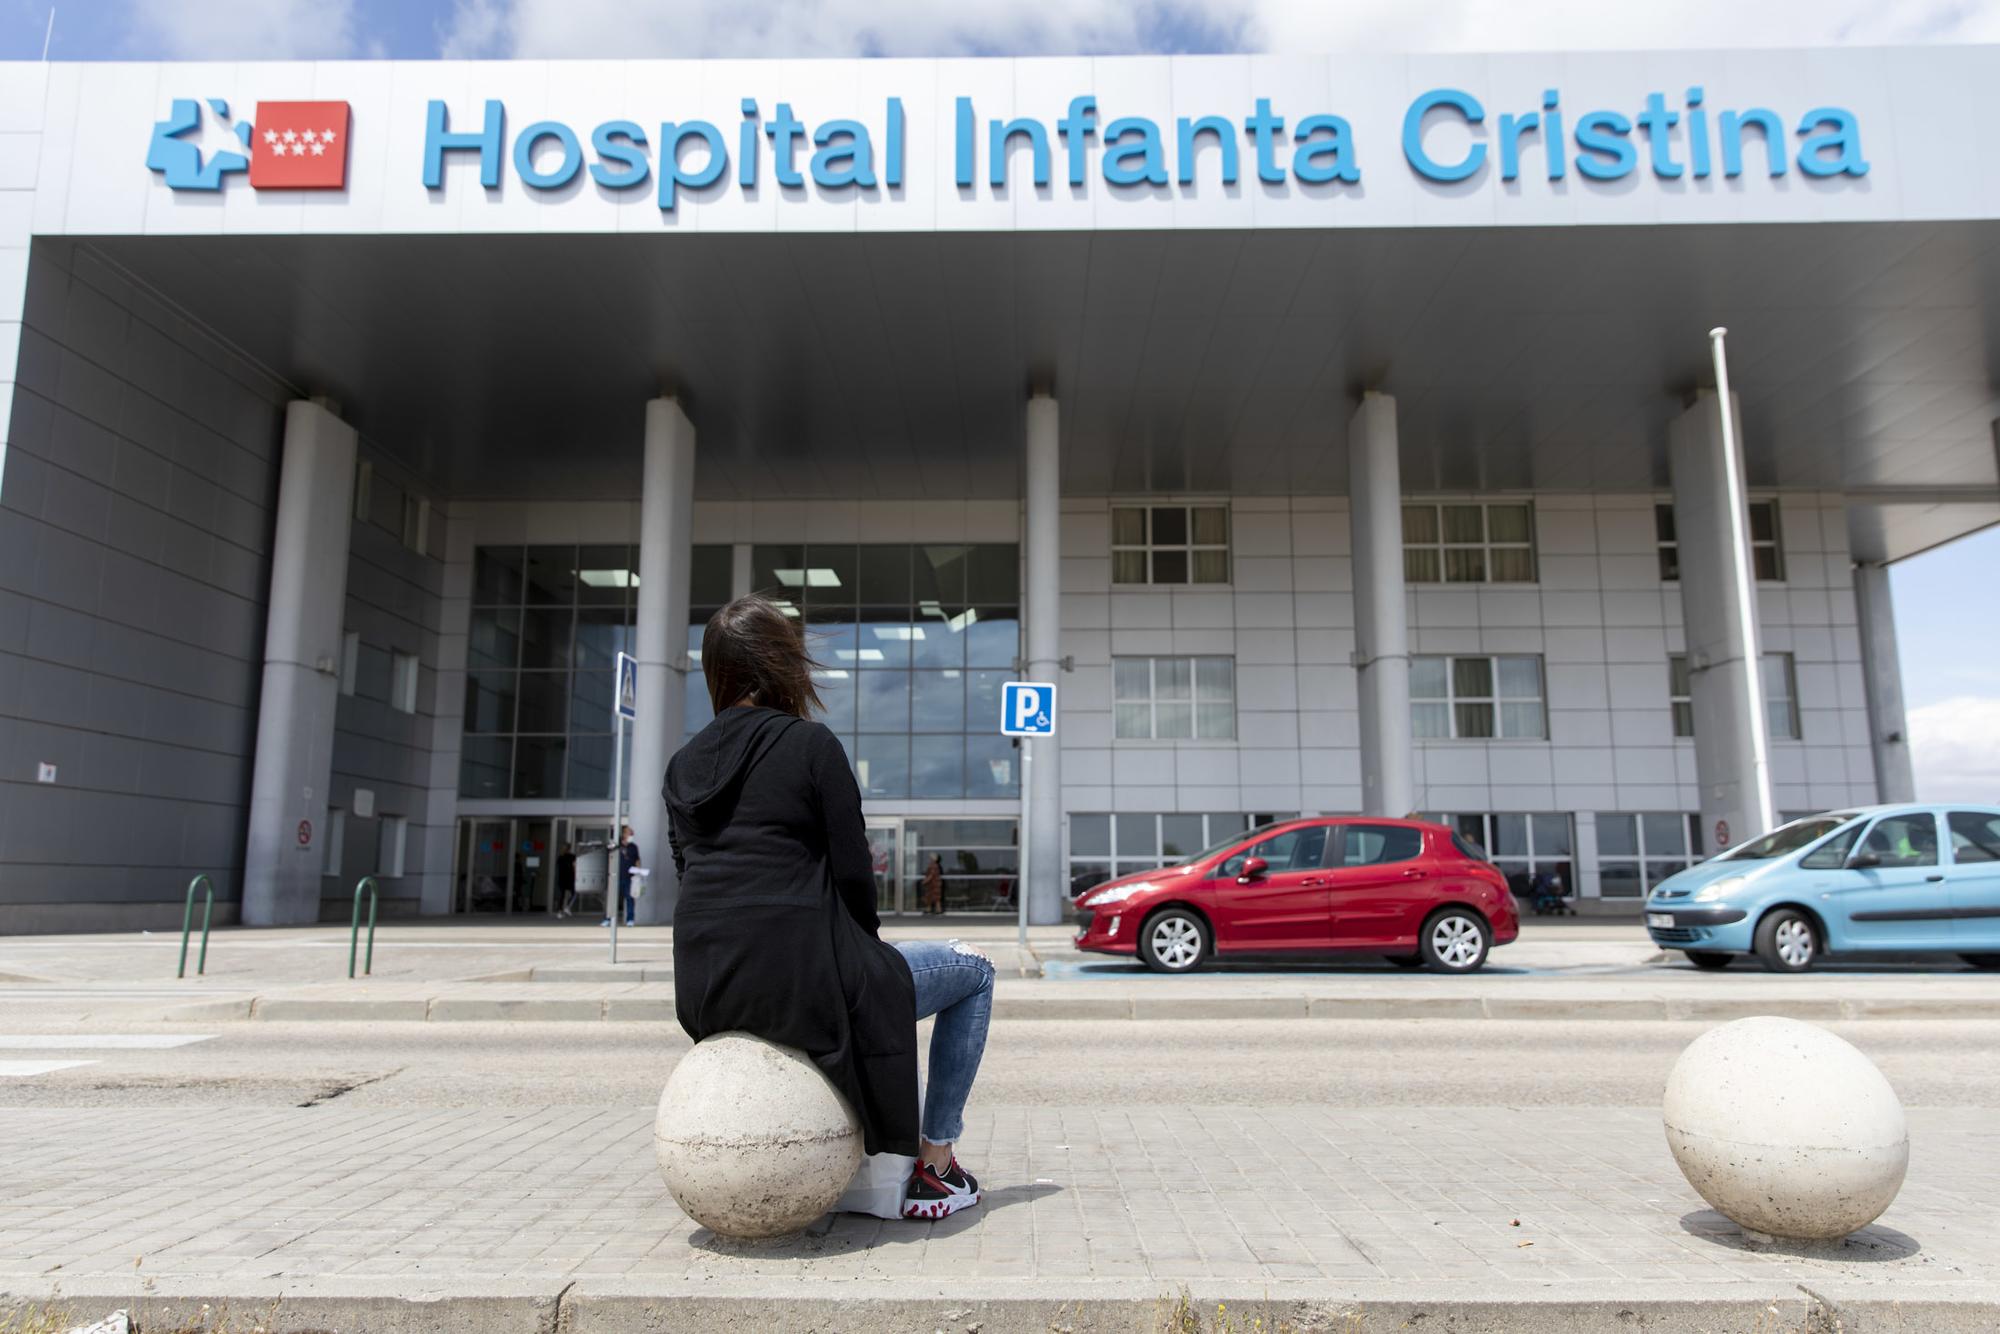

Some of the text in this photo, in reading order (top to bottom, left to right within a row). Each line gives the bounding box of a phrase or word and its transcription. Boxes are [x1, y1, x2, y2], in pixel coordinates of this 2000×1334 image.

[422, 86, 1871, 211] Hospital Infanta Cristina
[1015, 687, 1040, 729] P
